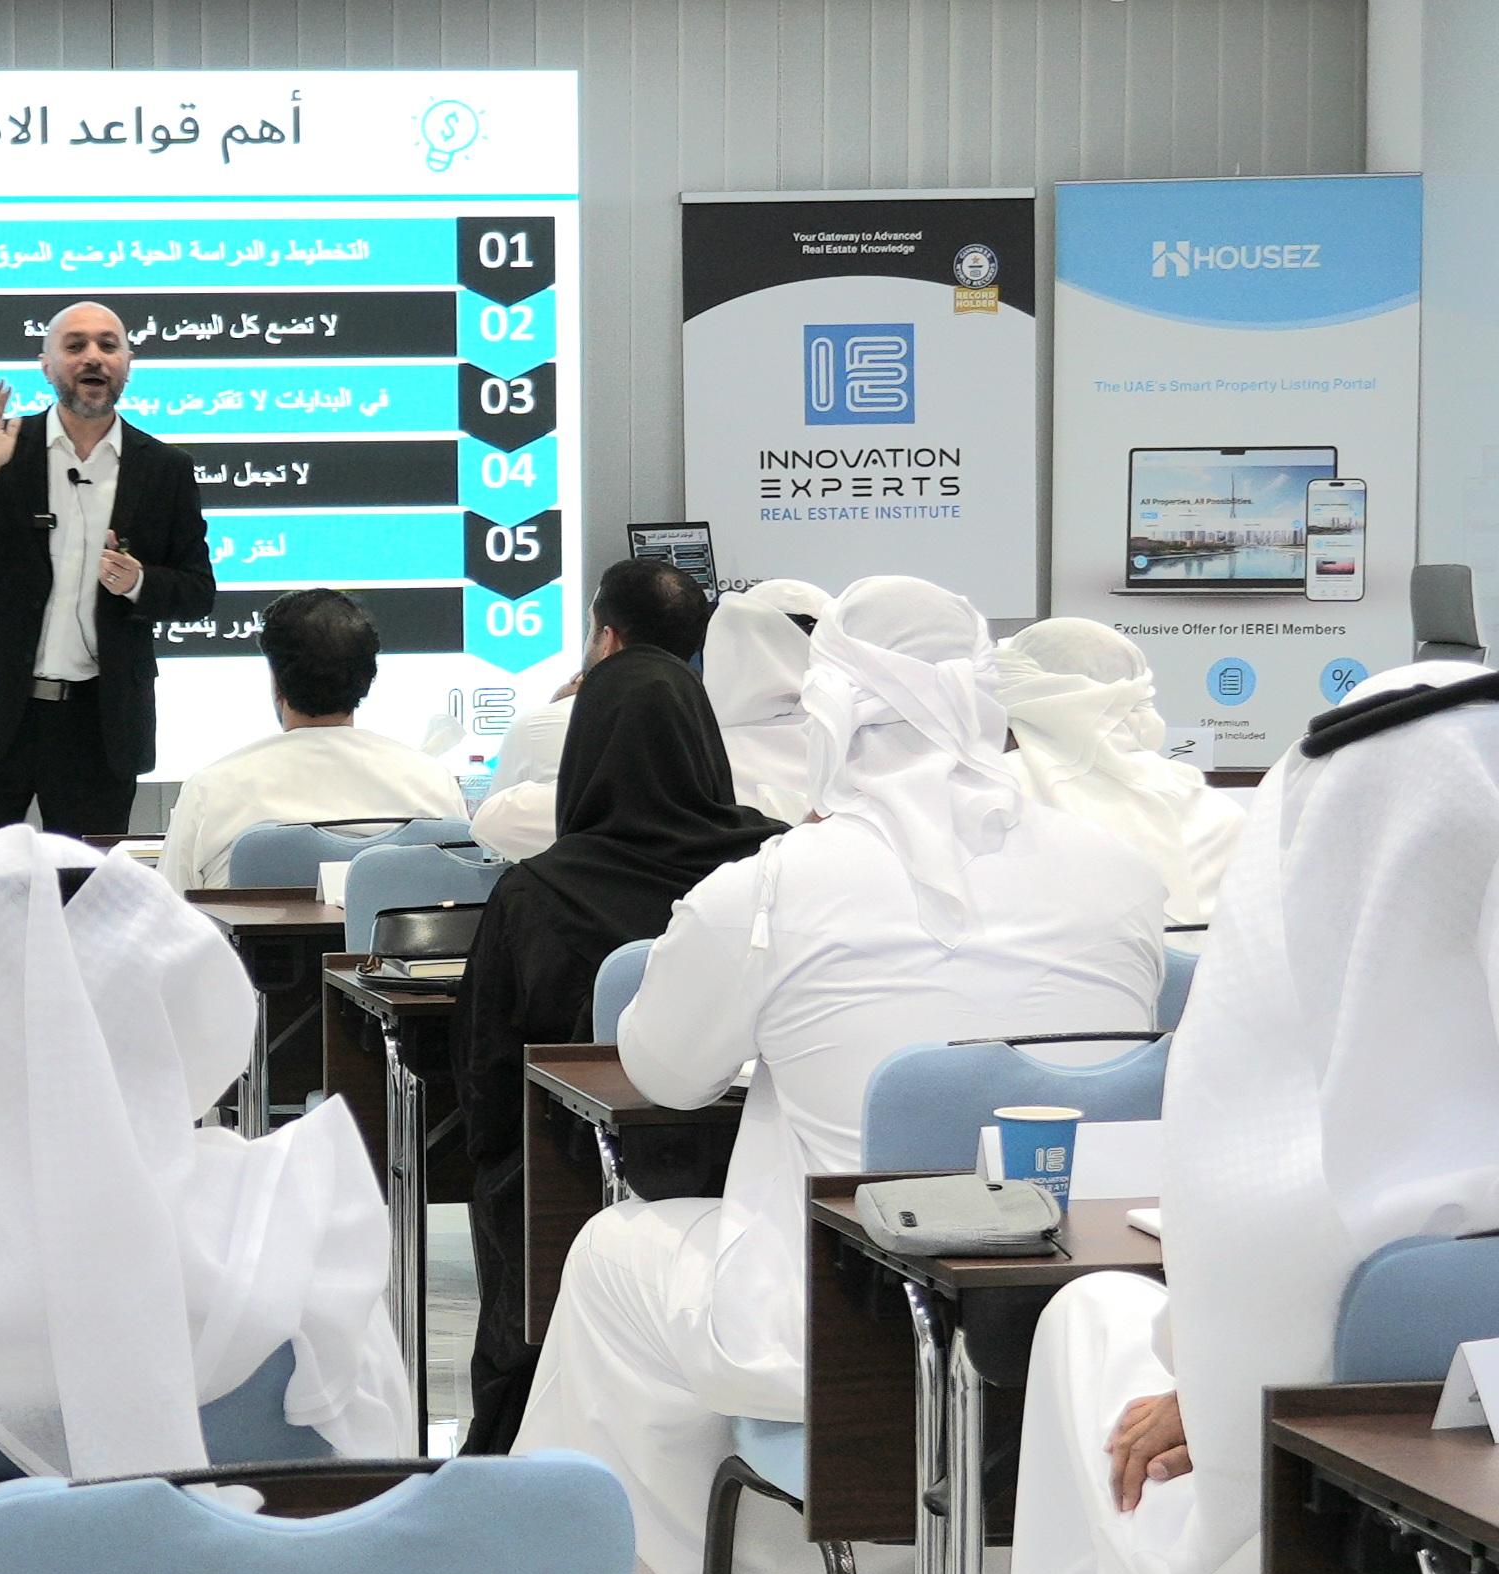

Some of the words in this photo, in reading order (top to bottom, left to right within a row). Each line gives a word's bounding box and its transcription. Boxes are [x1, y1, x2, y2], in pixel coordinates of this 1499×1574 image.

[70, 103, 200, 154] قواعد
[222, 89, 301, 164] أهم
[479, 231, 533, 269] 01
[793, 232, 816, 242] Your
[818, 232, 860, 243] Gateway
[862, 232, 872, 241] to
[873, 231, 922, 241] Advanced
[802, 245, 823, 254] Real
[826, 245, 857, 254] Estate
[861, 244, 915, 255] Knowledge
[285, 239, 369, 263] التخطيط
[1195, 243, 1320, 269] HOUSEZ
[128, 315, 157, 345] في
[163, 314, 222, 341] البيض
[228, 314, 260, 339] كل
[265, 314, 315, 344] تضع
[321, 315, 338, 337] لا
[480, 305, 534, 341] 02
[480, 378, 534, 415] 03
[1094, 381, 1120, 393] The
[1169, 380, 1212, 392] Smart
[1215, 379, 1277, 394] Property
[1281, 378, 1329, 393] Listing
[1332, 378, 1376, 390] Portal
[166, 388, 243, 419] تقترض
[250, 389, 268, 412] لا
[284, 387, 352, 413] البدايات
[359, 390, 389, 419] في
[481, 452, 535, 488] 04
[760, 448, 960, 469] INNOVATION
[234, 461, 286, 487] تجعل
[292, 462, 309, 485] لا
[761, 476, 960, 498] EXPERTS
[760, 508, 802, 521] REAL
[808, 507, 869, 520] ESTATE
[875, 505, 961, 519] INSTITUTE
[485, 525, 539, 562] 05
[487, 602, 541, 636] 06
[1114, 623, 1179, 635] Exclusive
[1182, 623, 1216, 635] Offer
[1219, 623, 1240, 635] for
[1282, 623, 1346, 635] Members
